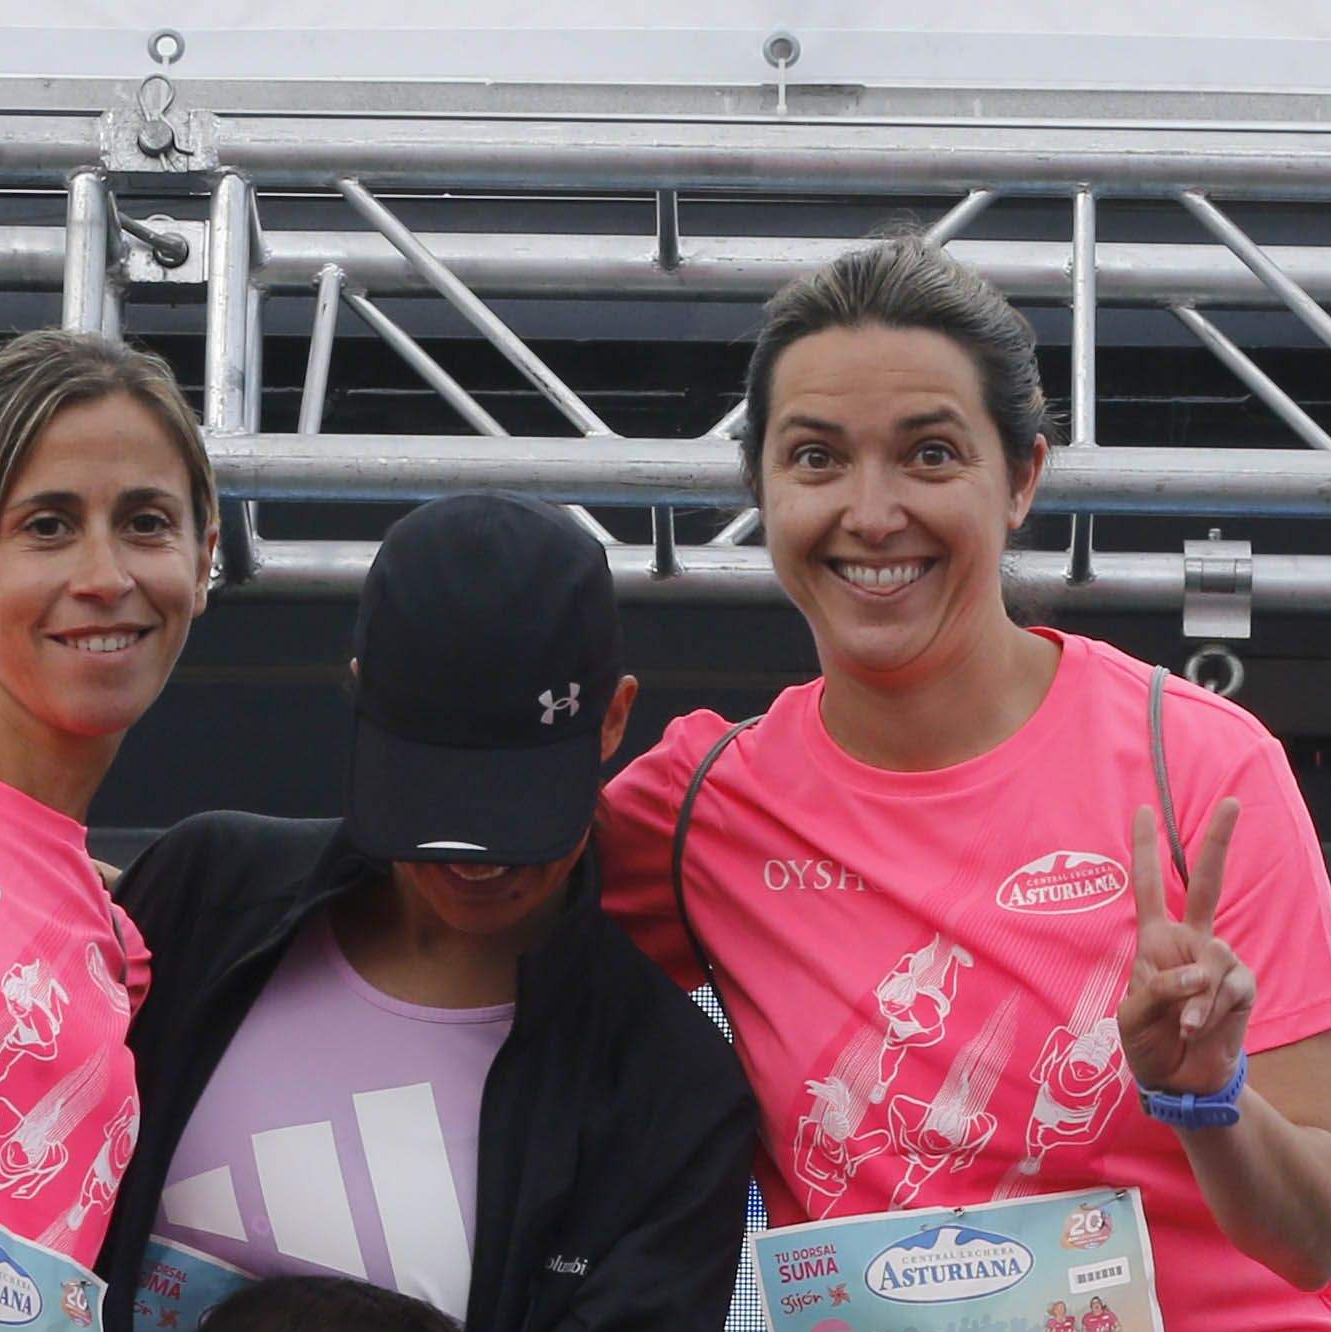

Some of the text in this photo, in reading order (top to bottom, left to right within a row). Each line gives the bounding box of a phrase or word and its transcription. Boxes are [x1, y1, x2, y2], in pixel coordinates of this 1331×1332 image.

[764, 859, 868, 892] OYSH
[1008, 874, 1120, 906] ASTURIANA
[1070, 1209, 1104, 1235] 20
[774, 1244, 837, 1264] TU DORSAL
[778, 1257, 839, 1284] SUMA
[879, 1257, 1023, 1291] ASTURIANA
